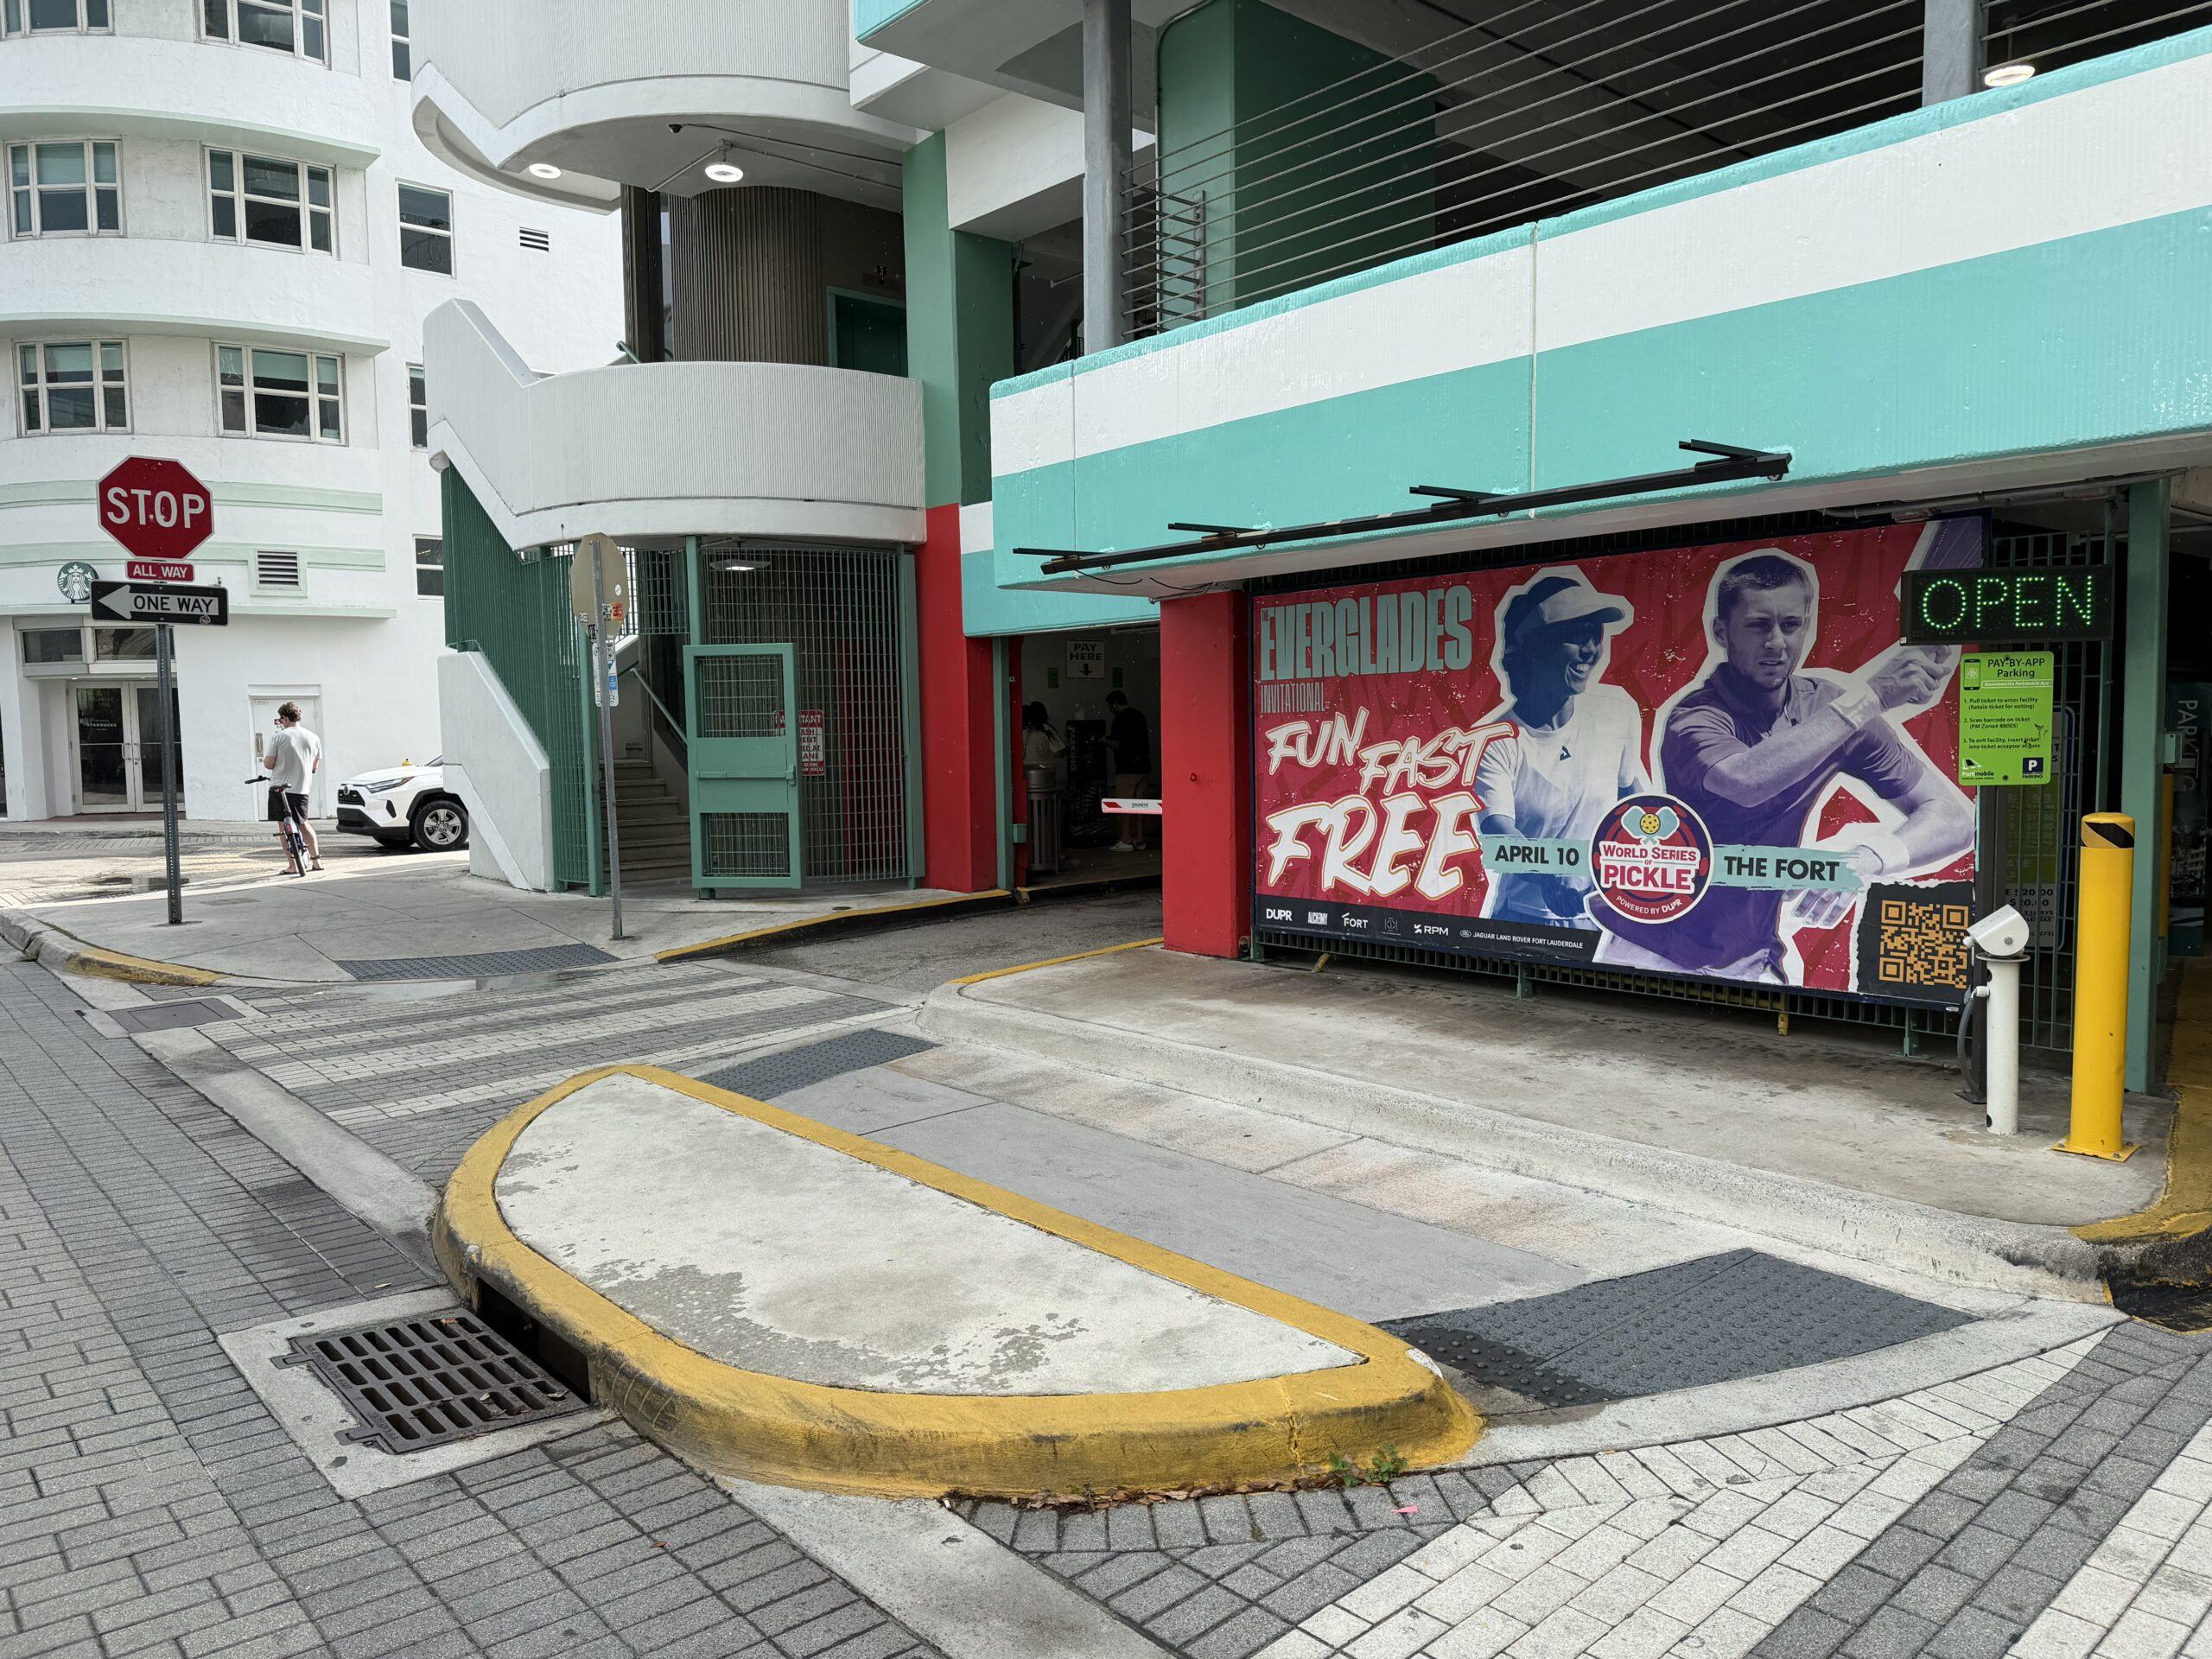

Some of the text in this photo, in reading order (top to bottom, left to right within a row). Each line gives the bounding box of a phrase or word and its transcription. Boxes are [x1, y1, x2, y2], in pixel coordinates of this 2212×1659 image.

[107, 487, 205, 529] STOP
[133, 564, 188, 578] ALL WAY
[134, 595, 213, 613] ONE WAY
[1923, 575, 2093, 629] OPEN
[1261, 585, 1472, 680] EVERGLADES
[1074, 643, 1097, 652] PAY
[1070, 652, 1102, 661] HERE
[1987, 658, 2045, 667] PAY-BY-APP
[1997, 669, 2035, 678] Parking
[1261, 682, 1325, 713] INVITATIONAL
[1266, 706, 1515, 796] FUN FAST
[2028, 760, 2037, 772] P
[1265, 791, 1482, 900] FREE
[1603, 845, 1696, 861] WORLD SERIES
[1495, 845, 1580, 866] APRIL 10
[1724, 855, 1840, 881] THE FORT
[1605, 865, 1691, 890] PICKLE
[1617, 895, 1649, 914] POWERED
[1662, 899, 1682, 912] DUPR
[1266, 908, 1293, 921] DUPR
[1308, 912, 1328, 925] ALCHEMY
[1342, 912, 1369, 929] FORT
[1424, 925, 1449, 936] RPM
[1547, 939, 1583, 949] LAUDERDALE
